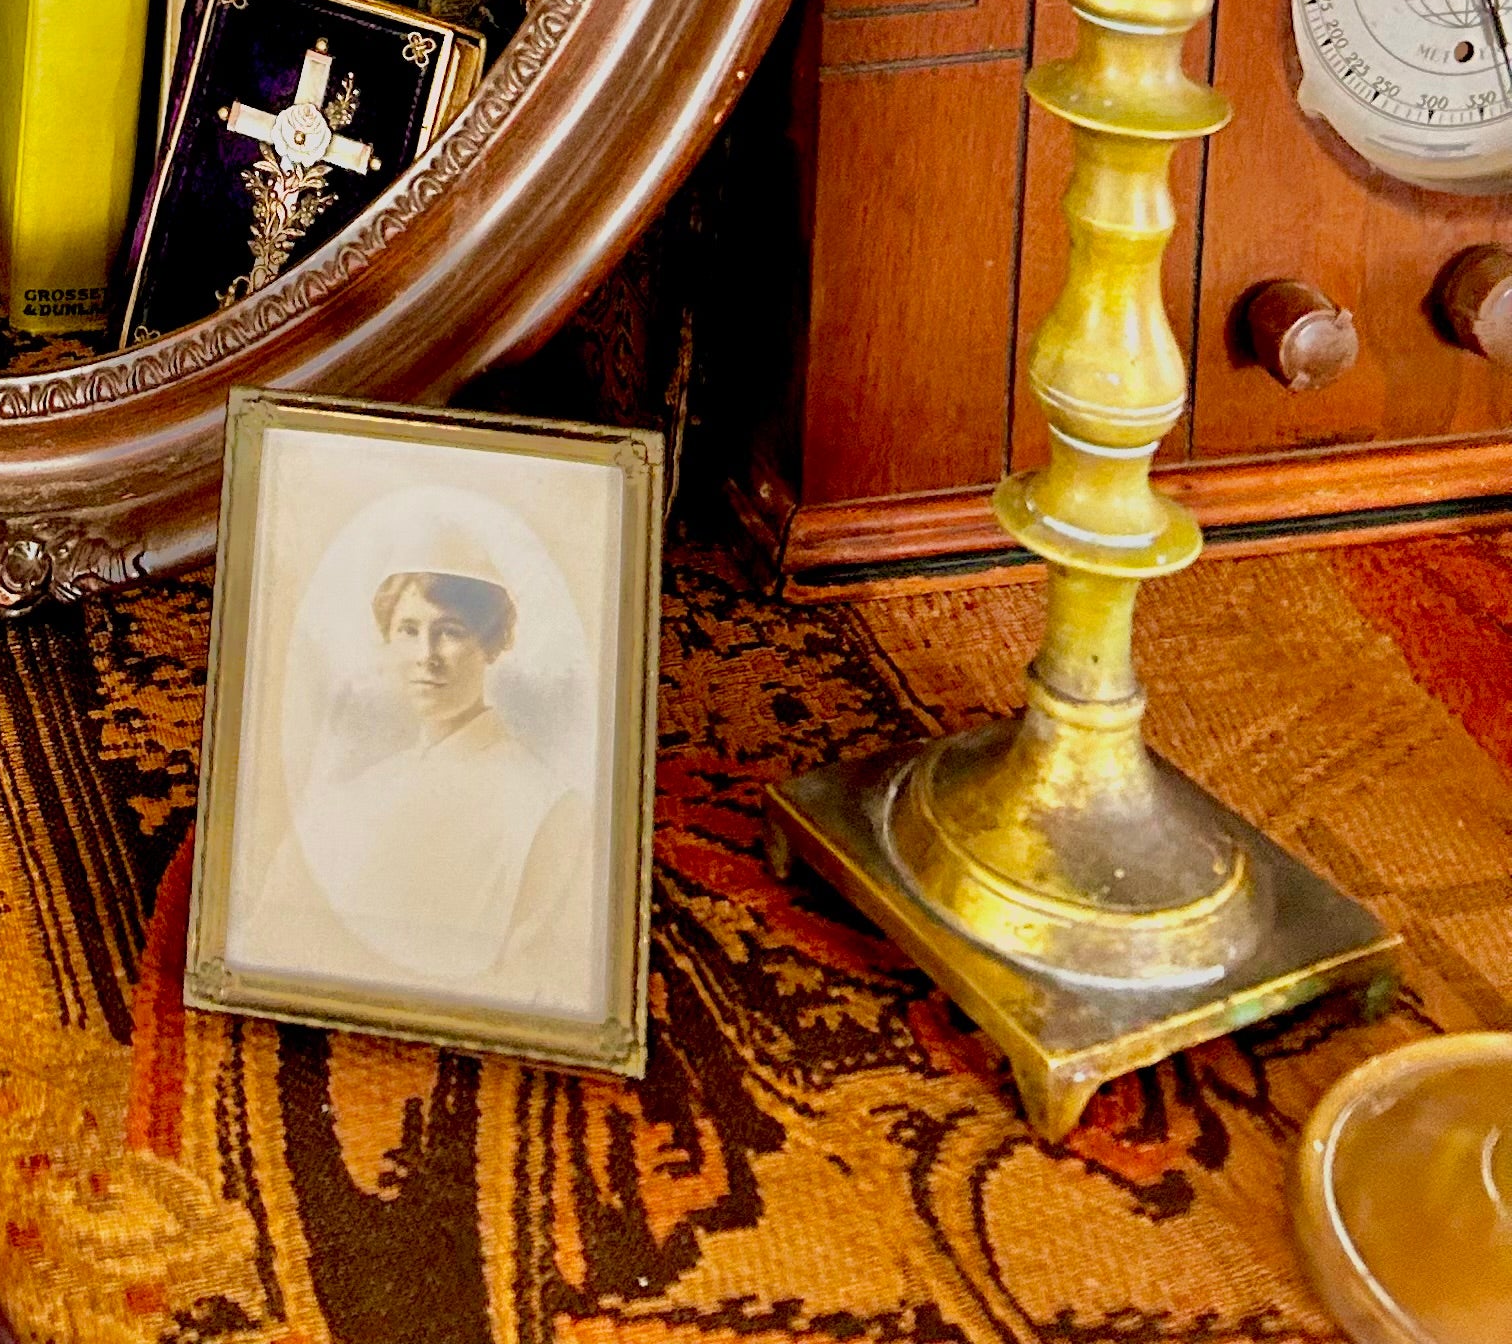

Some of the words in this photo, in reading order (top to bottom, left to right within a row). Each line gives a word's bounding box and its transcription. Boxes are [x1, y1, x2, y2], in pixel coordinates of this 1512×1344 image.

[1327, 18, 1350, 50] 200
[1372, 76, 1401, 99] 250
[1416, 94, 1449, 110] 300
